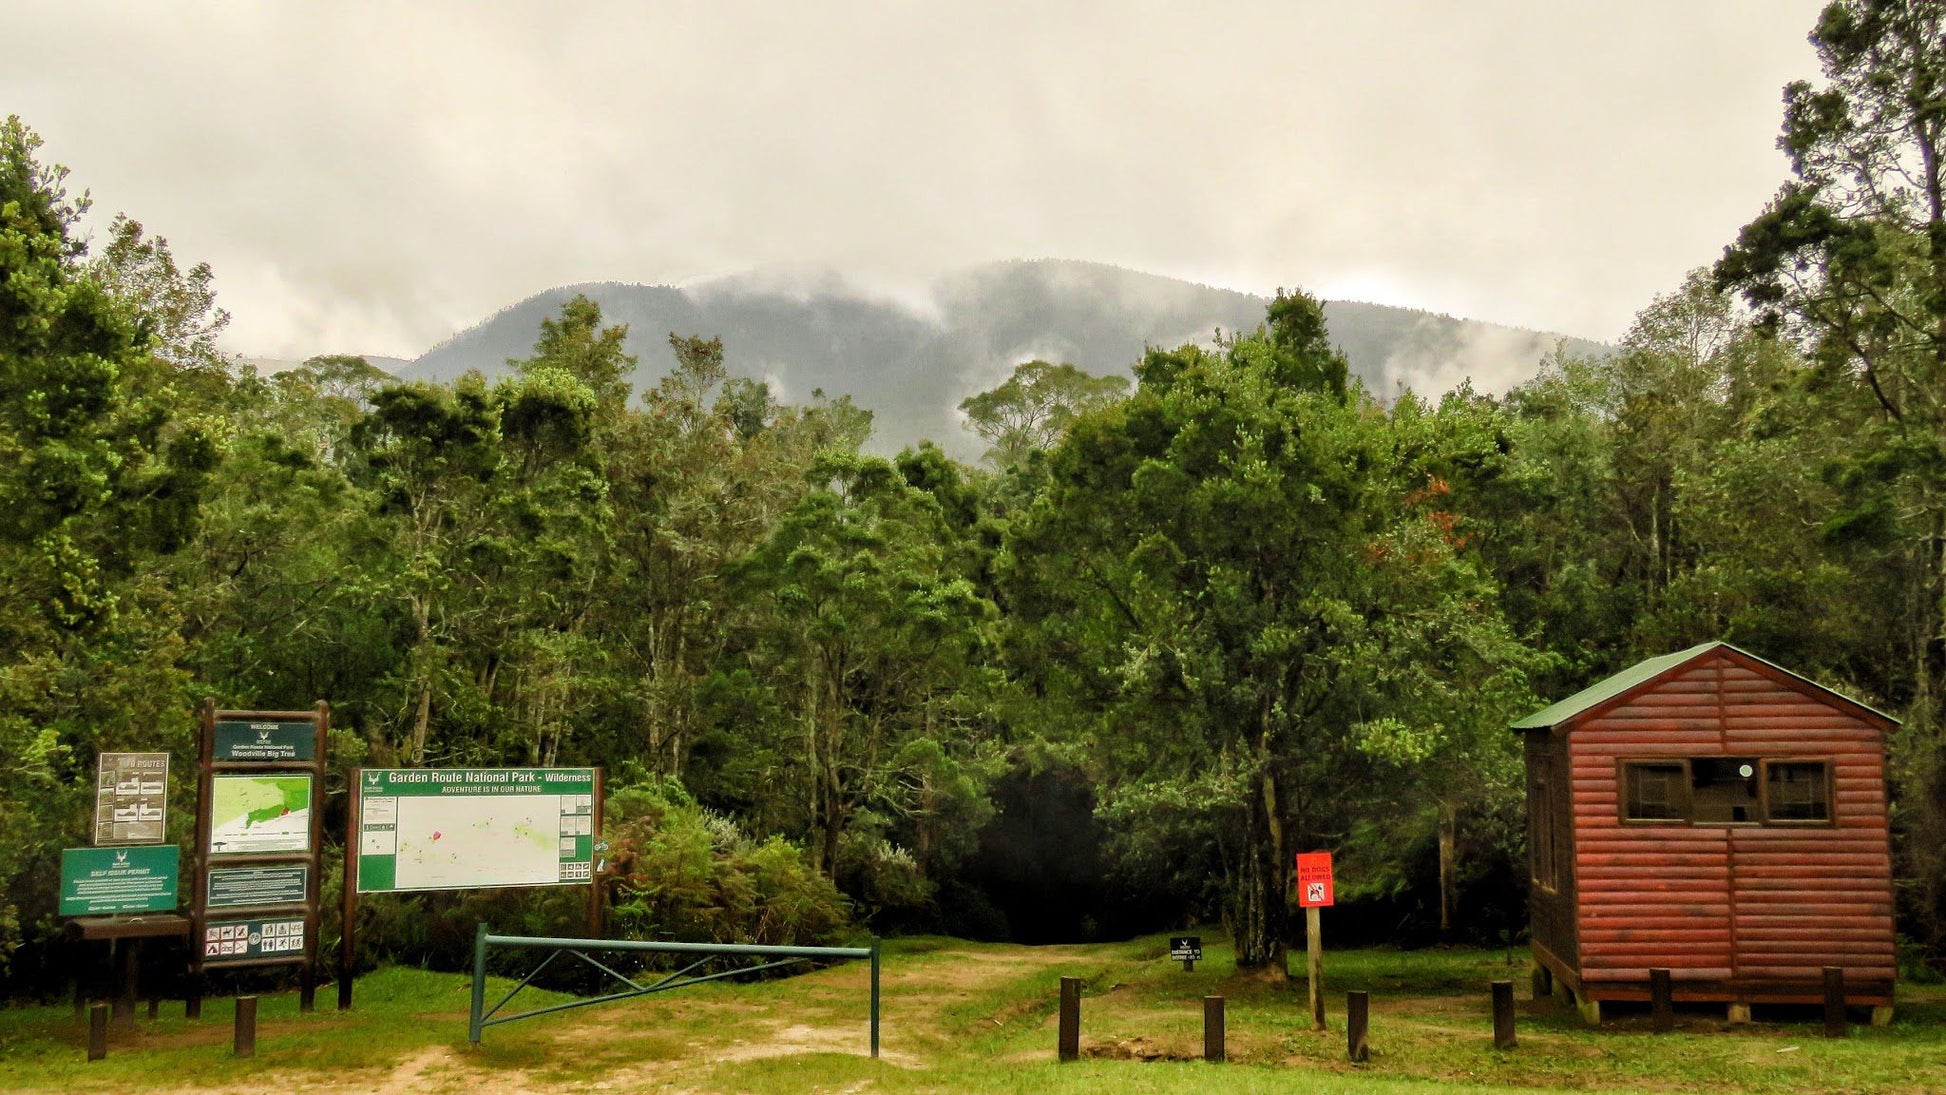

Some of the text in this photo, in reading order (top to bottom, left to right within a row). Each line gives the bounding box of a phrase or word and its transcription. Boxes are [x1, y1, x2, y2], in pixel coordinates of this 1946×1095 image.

[267, 750, 279, 758] Big
[388, 772, 428, 783] Garden
[431, 772, 462, 783] Route
[465, 772, 509, 783] National
[511, 772, 536, 782] Park
[544, 773, 591, 782] Wilderness
[515, 785, 542, 793] NATURE
